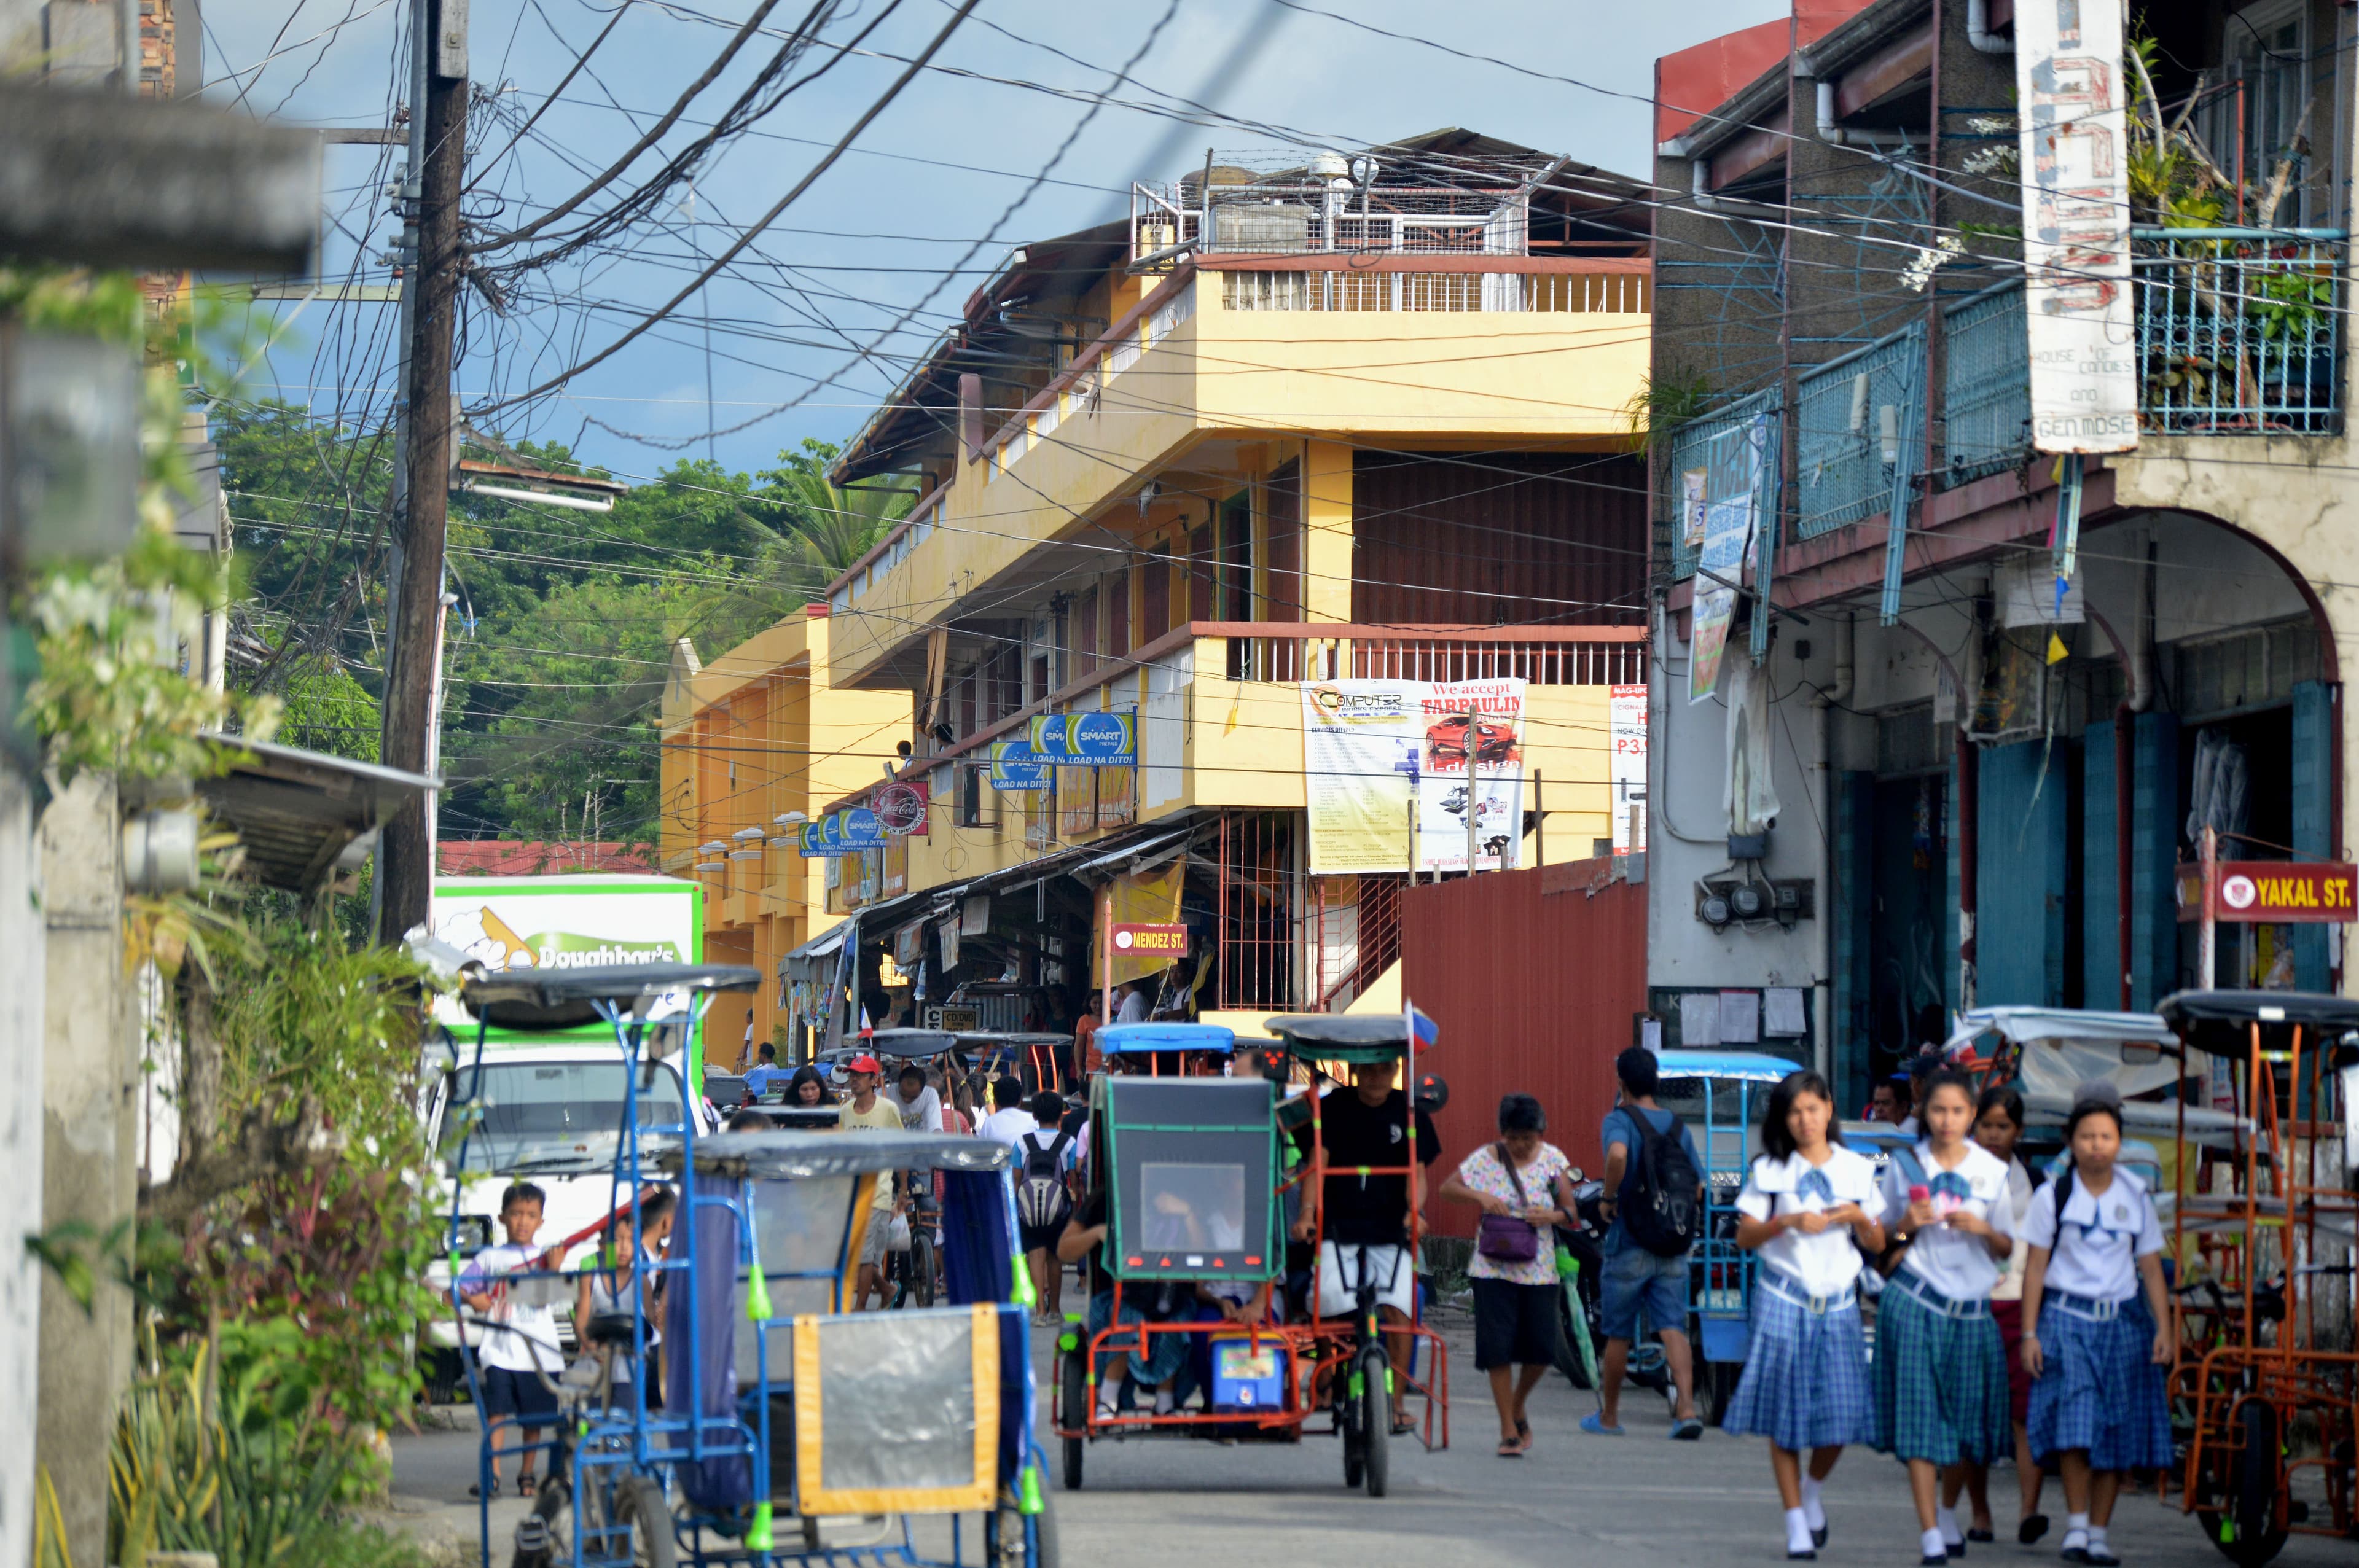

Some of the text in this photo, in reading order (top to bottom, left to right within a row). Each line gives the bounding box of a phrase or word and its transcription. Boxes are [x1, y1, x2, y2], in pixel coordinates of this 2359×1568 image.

[2033, 348, 2111, 364] HOUSE OF
[2079, 361, 2132, 374] CANDIES
[1432, 683, 1511, 696] We accept
[1421, 696, 1520, 715] TARPAULIN
[1081, 731, 1121, 741] SMART
[2256, 877, 2352, 908] YAKAL ST.
[1133, 932, 1183, 948] MENDEZ ST.
